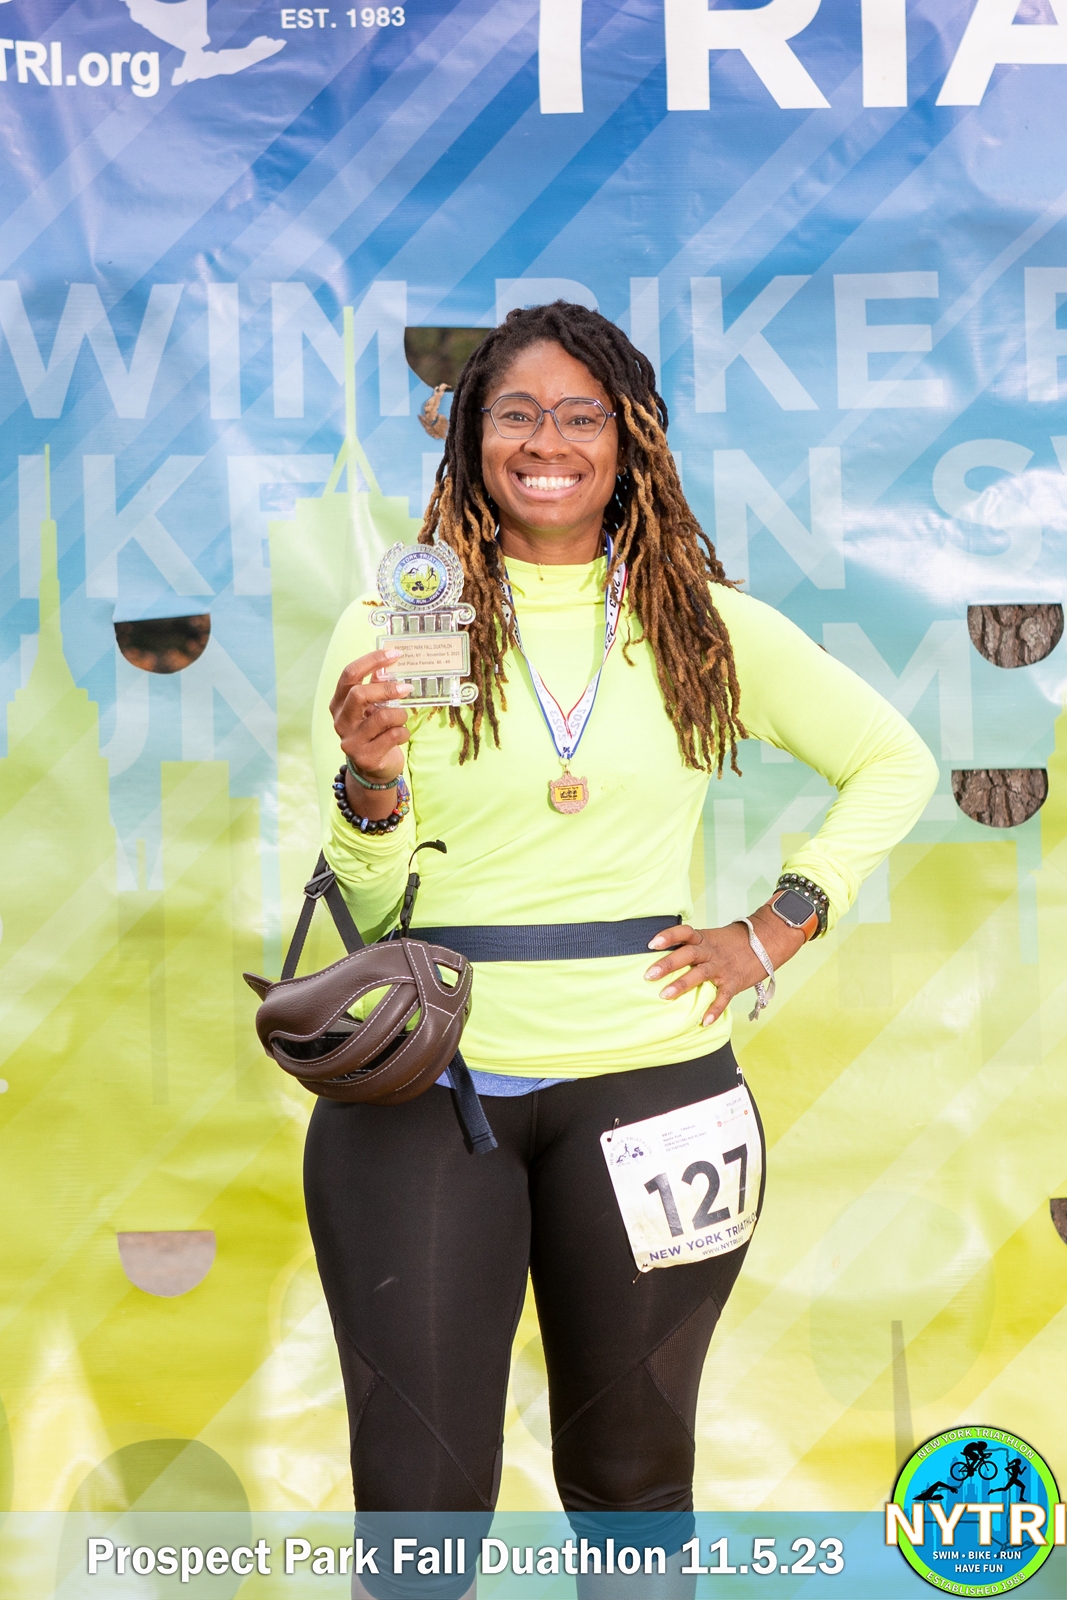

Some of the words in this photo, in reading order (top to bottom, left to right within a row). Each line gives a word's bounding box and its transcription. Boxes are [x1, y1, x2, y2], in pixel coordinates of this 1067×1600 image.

[280, 8, 337, 29] EST.
[346, 6, 406, 28] 1983
[644, 1143, 748, 1238] 127
[650, 1245, 681, 1261] NEW
[686, 1232, 723, 1251] YORK
[726, 1211, 757, 1238] TRIATHLO
